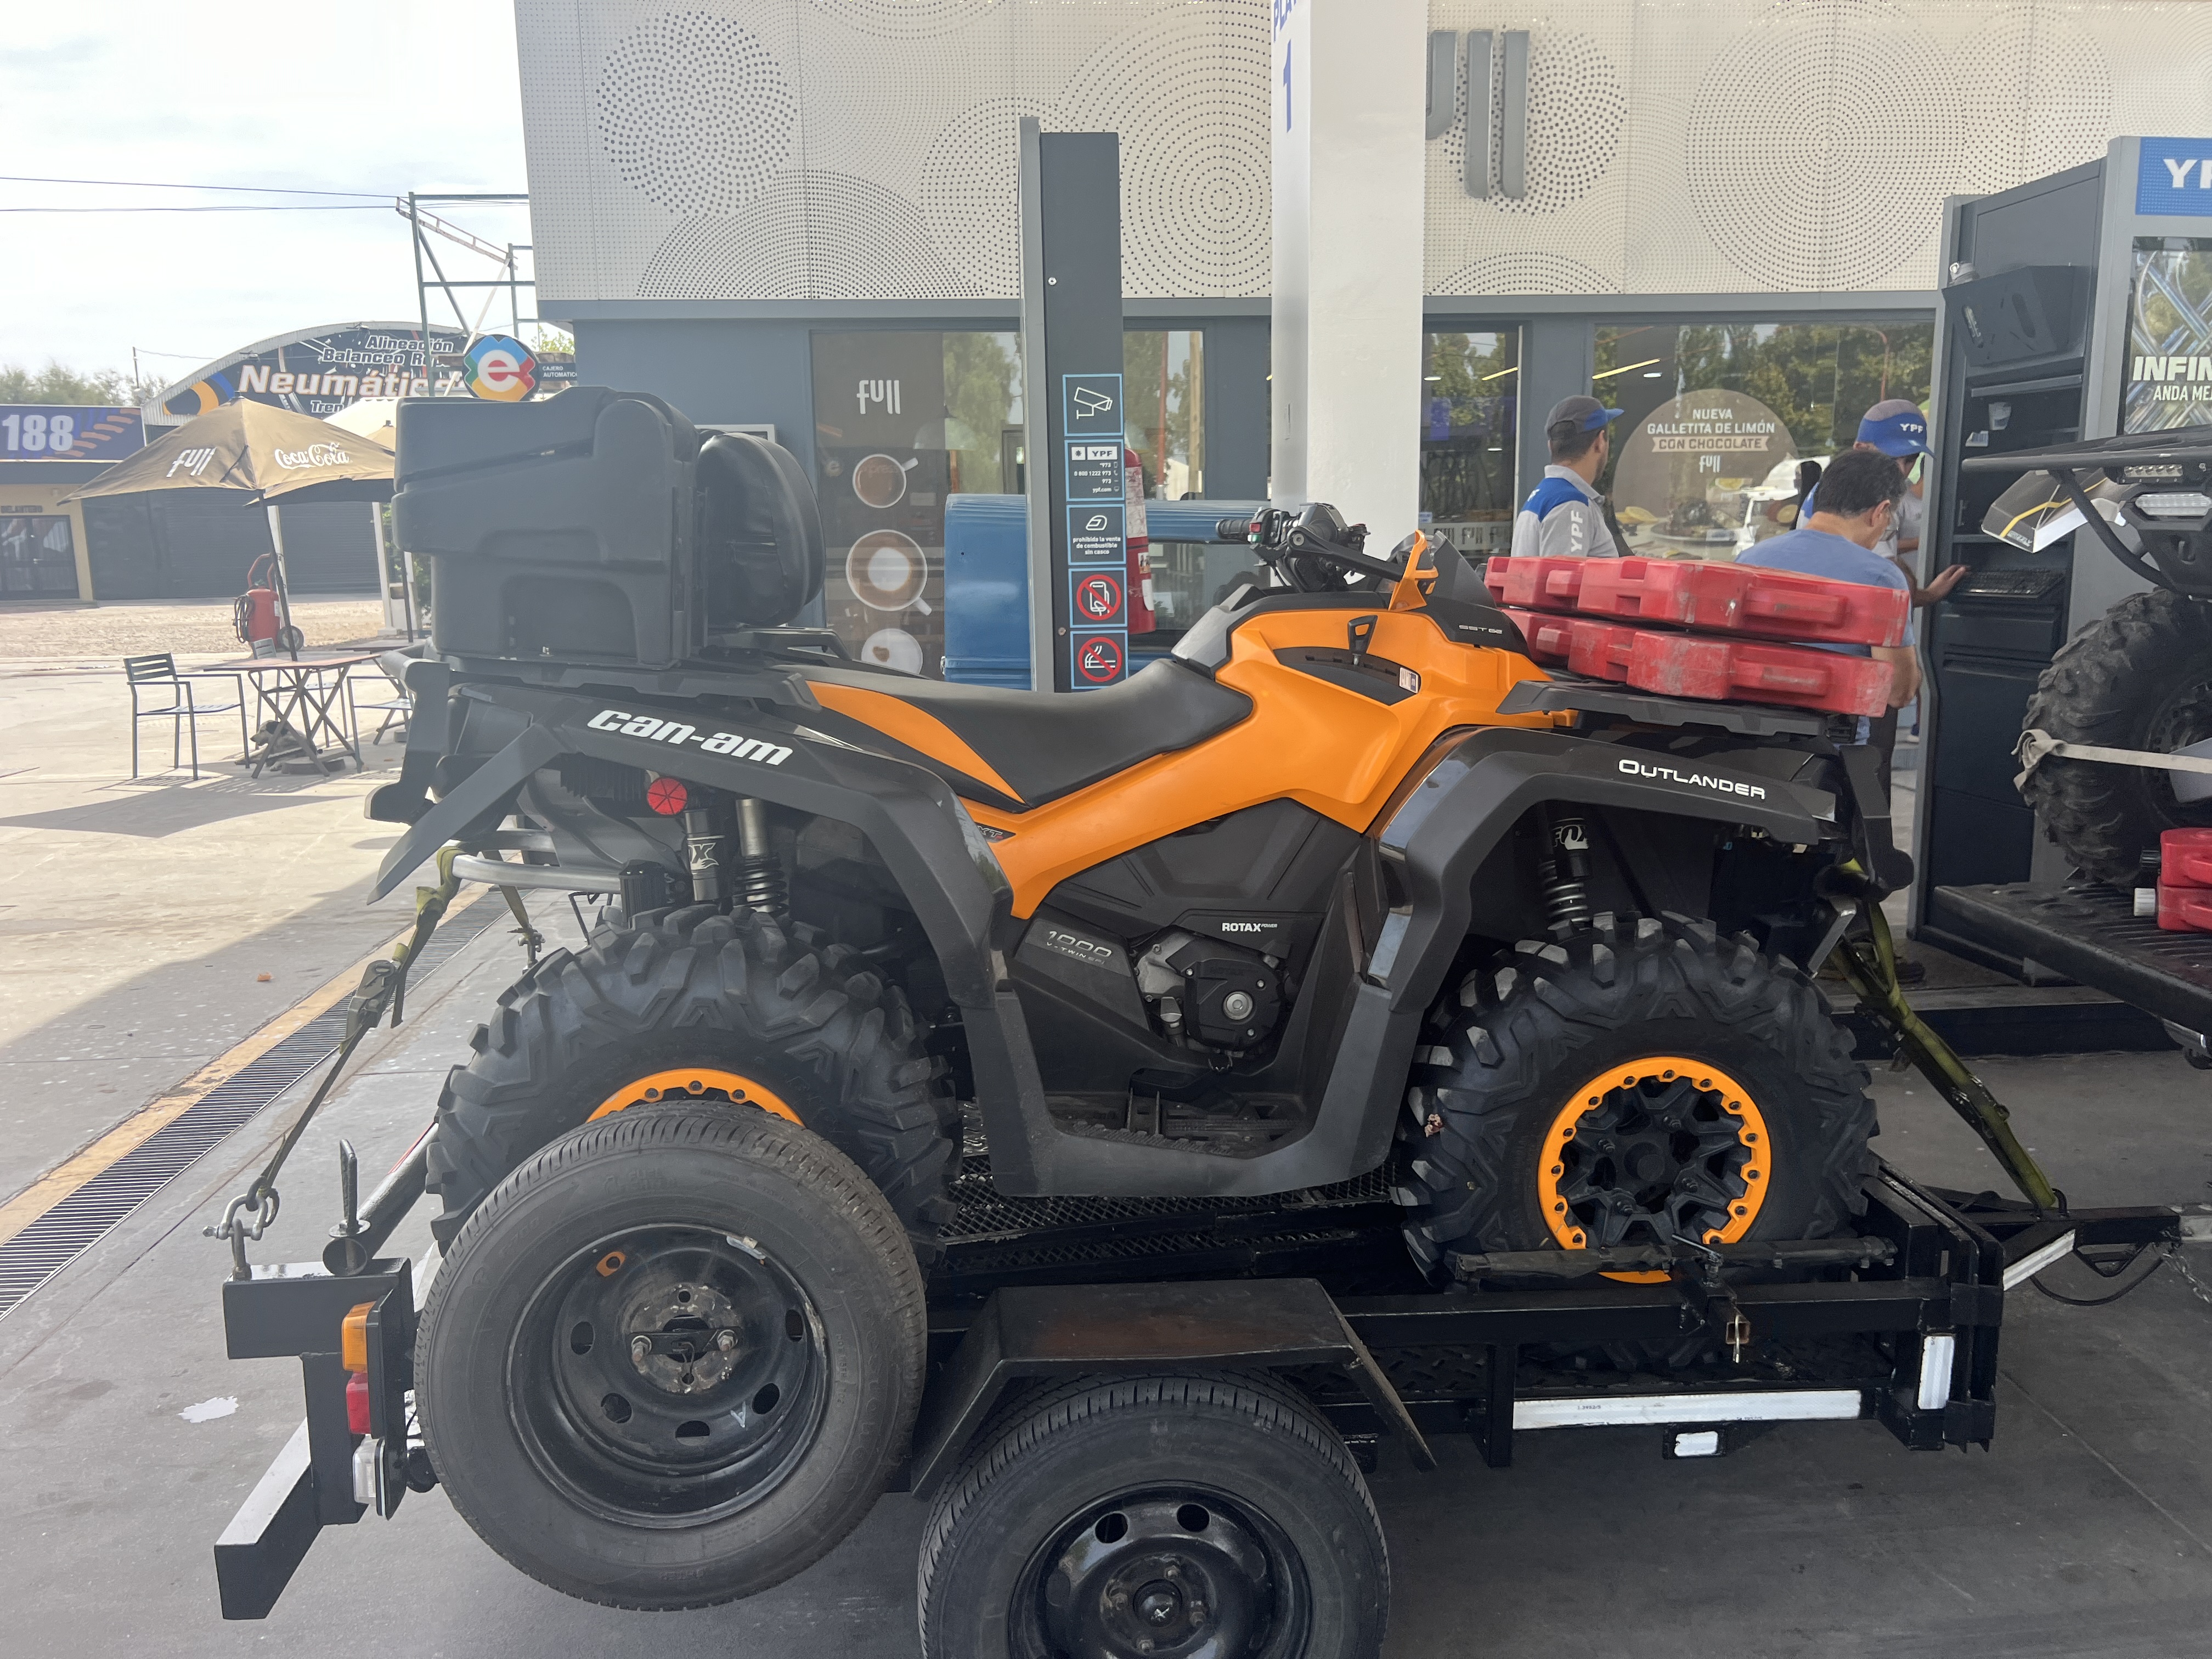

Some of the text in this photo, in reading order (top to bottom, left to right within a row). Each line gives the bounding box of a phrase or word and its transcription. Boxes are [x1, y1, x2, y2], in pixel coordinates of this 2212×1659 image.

[1283, 38, 1291, 133] 1
[322, 347, 405, 365] Balanceo
[2153, 385, 2188, 401] ANDA
[1692, 408, 1733, 420] NUEVA
[2, 414, 74, 452] 188
[1647, 419, 1775, 435] GALLETITA DE LIMÓN
[1900, 423, 1923, 433] YPF
[1658, 438, 1762, 449] CON CHOCOLATE
[1570, 510, 1583, 552] YPF
[1222, 922, 1261, 932] ROTAX
[1048, 930, 1112, 957] 1000
